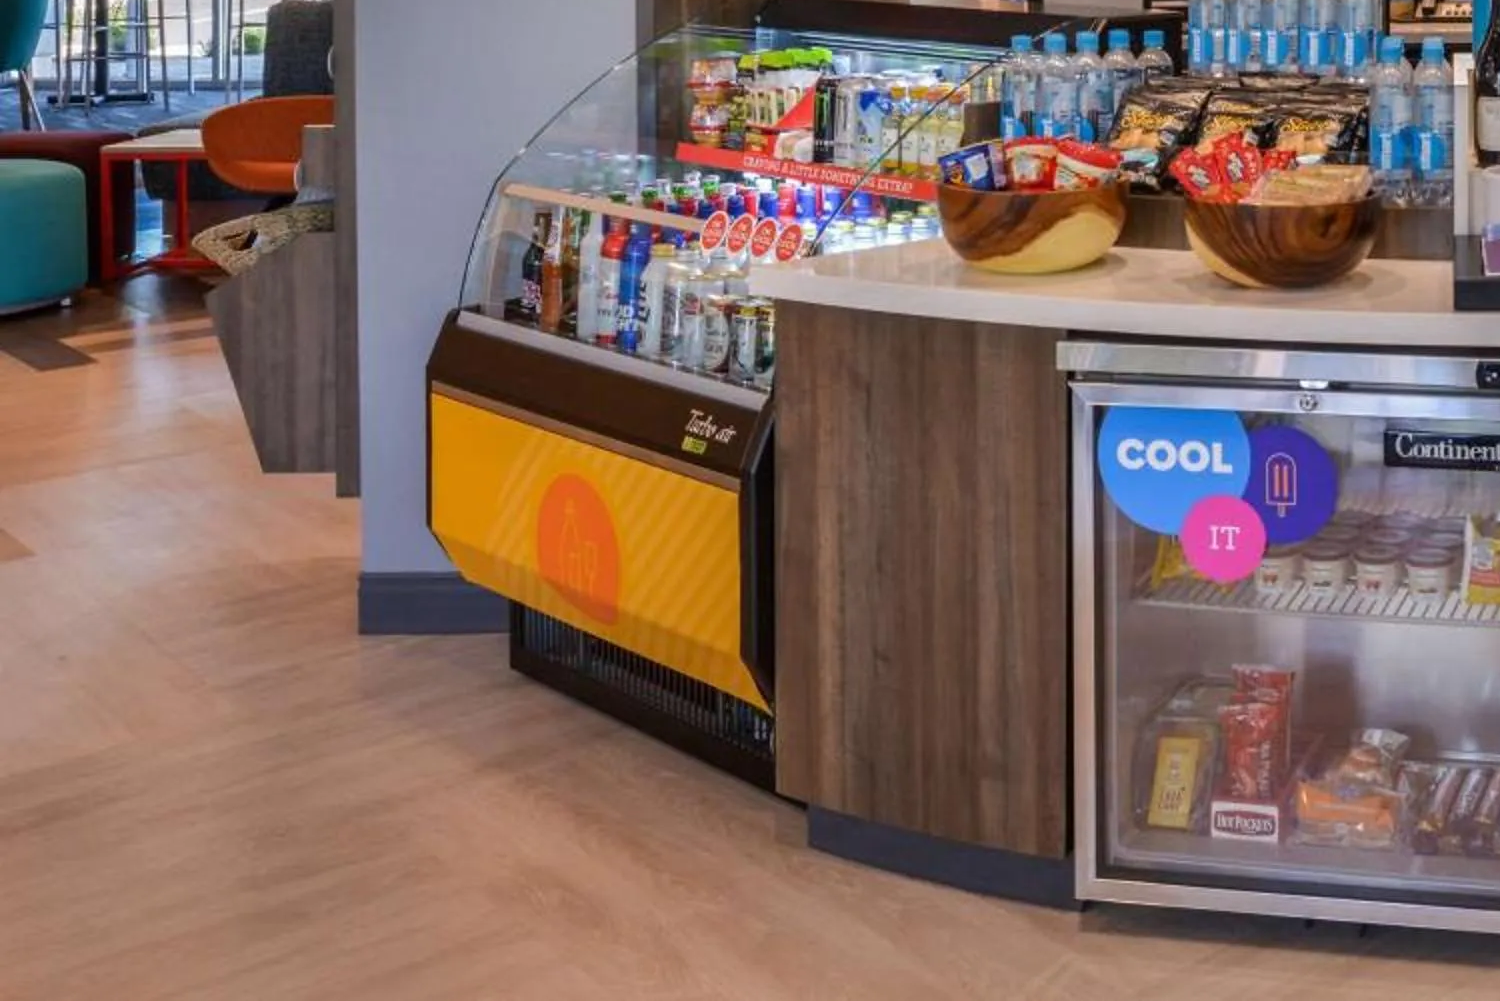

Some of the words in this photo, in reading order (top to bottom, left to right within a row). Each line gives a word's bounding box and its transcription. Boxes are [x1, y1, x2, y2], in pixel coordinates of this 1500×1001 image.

[1116, 438, 1233, 474] COOL
[1209, 524, 1241, 551] IT
[1216, 814, 1234, 827] HOT
[1235, 815, 1273, 832] POCKETS
